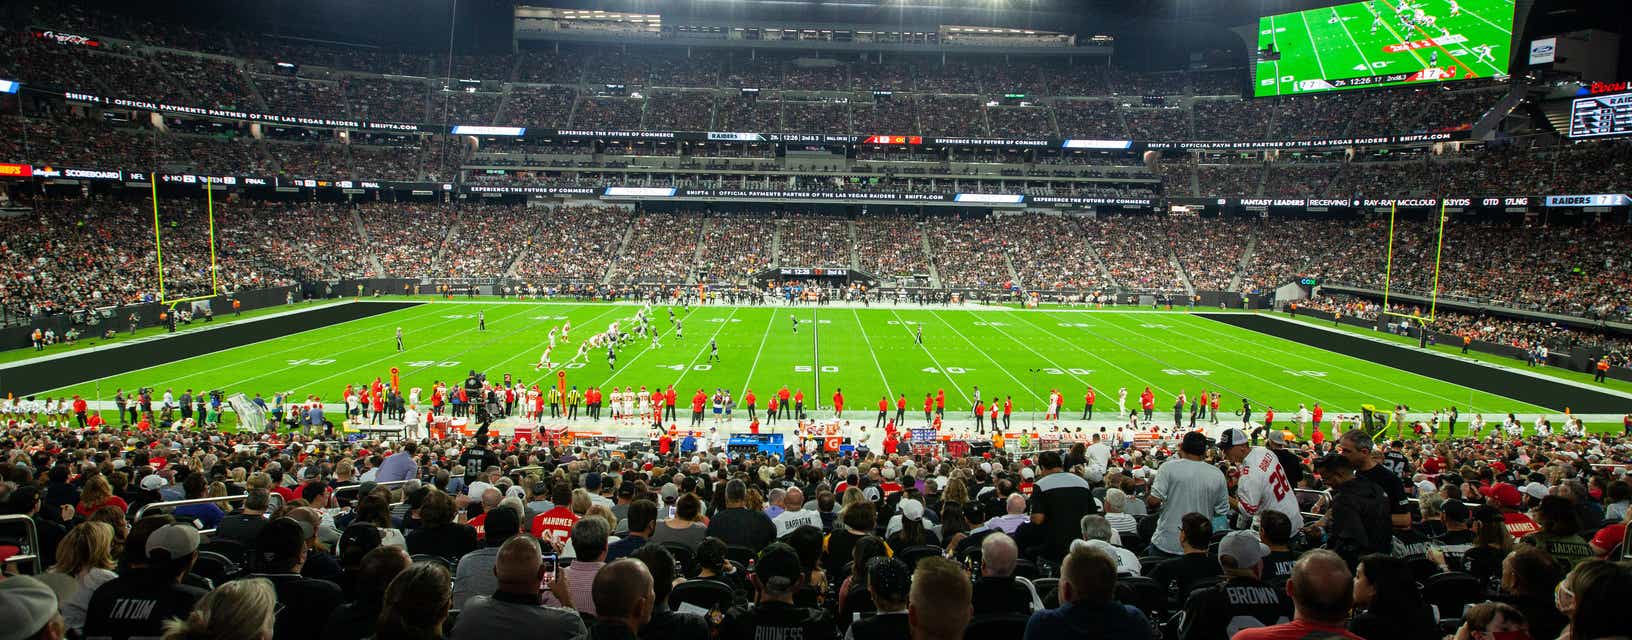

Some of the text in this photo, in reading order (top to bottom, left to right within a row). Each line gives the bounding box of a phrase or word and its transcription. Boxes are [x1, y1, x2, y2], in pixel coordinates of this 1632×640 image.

[1350, 77, 1371, 86] 12:26
[64, 92, 100, 103] SHIFT4
[114, 98, 157, 111] OFFICIAL
[160, 103, 207, 116] PAYMENTS
[209, 109, 248, 119] PARTNER
[298, 117, 324, 126] VEGAS
[326, 119, 359, 128] RAIDERS
[370, 122, 418, 131] SHIFT4.COM
[64, 168, 119, 179] SCOREBOARD
[130, 172, 145, 181] NFL
[245, 177, 267, 185] FINAL
[361, 181, 380, 189] FINAL
[1273, 199, 1305, 207] LEADERS
[1363, 199, 1396, 207] RAY-RAY
[1396, 199, 1437, 207] MCCLOUD
[1552, 196, 1591, 204] RAIDERS
[1301, 278, 1316, 286] COX
[794, 365, 840, 373] 50
[828, 438, 841, 450] G
[542, 516, 574, 528] MAHOMES
[1225, 586, 1280, 605] BROWN
[108, 597, 158, 621] TATUM
